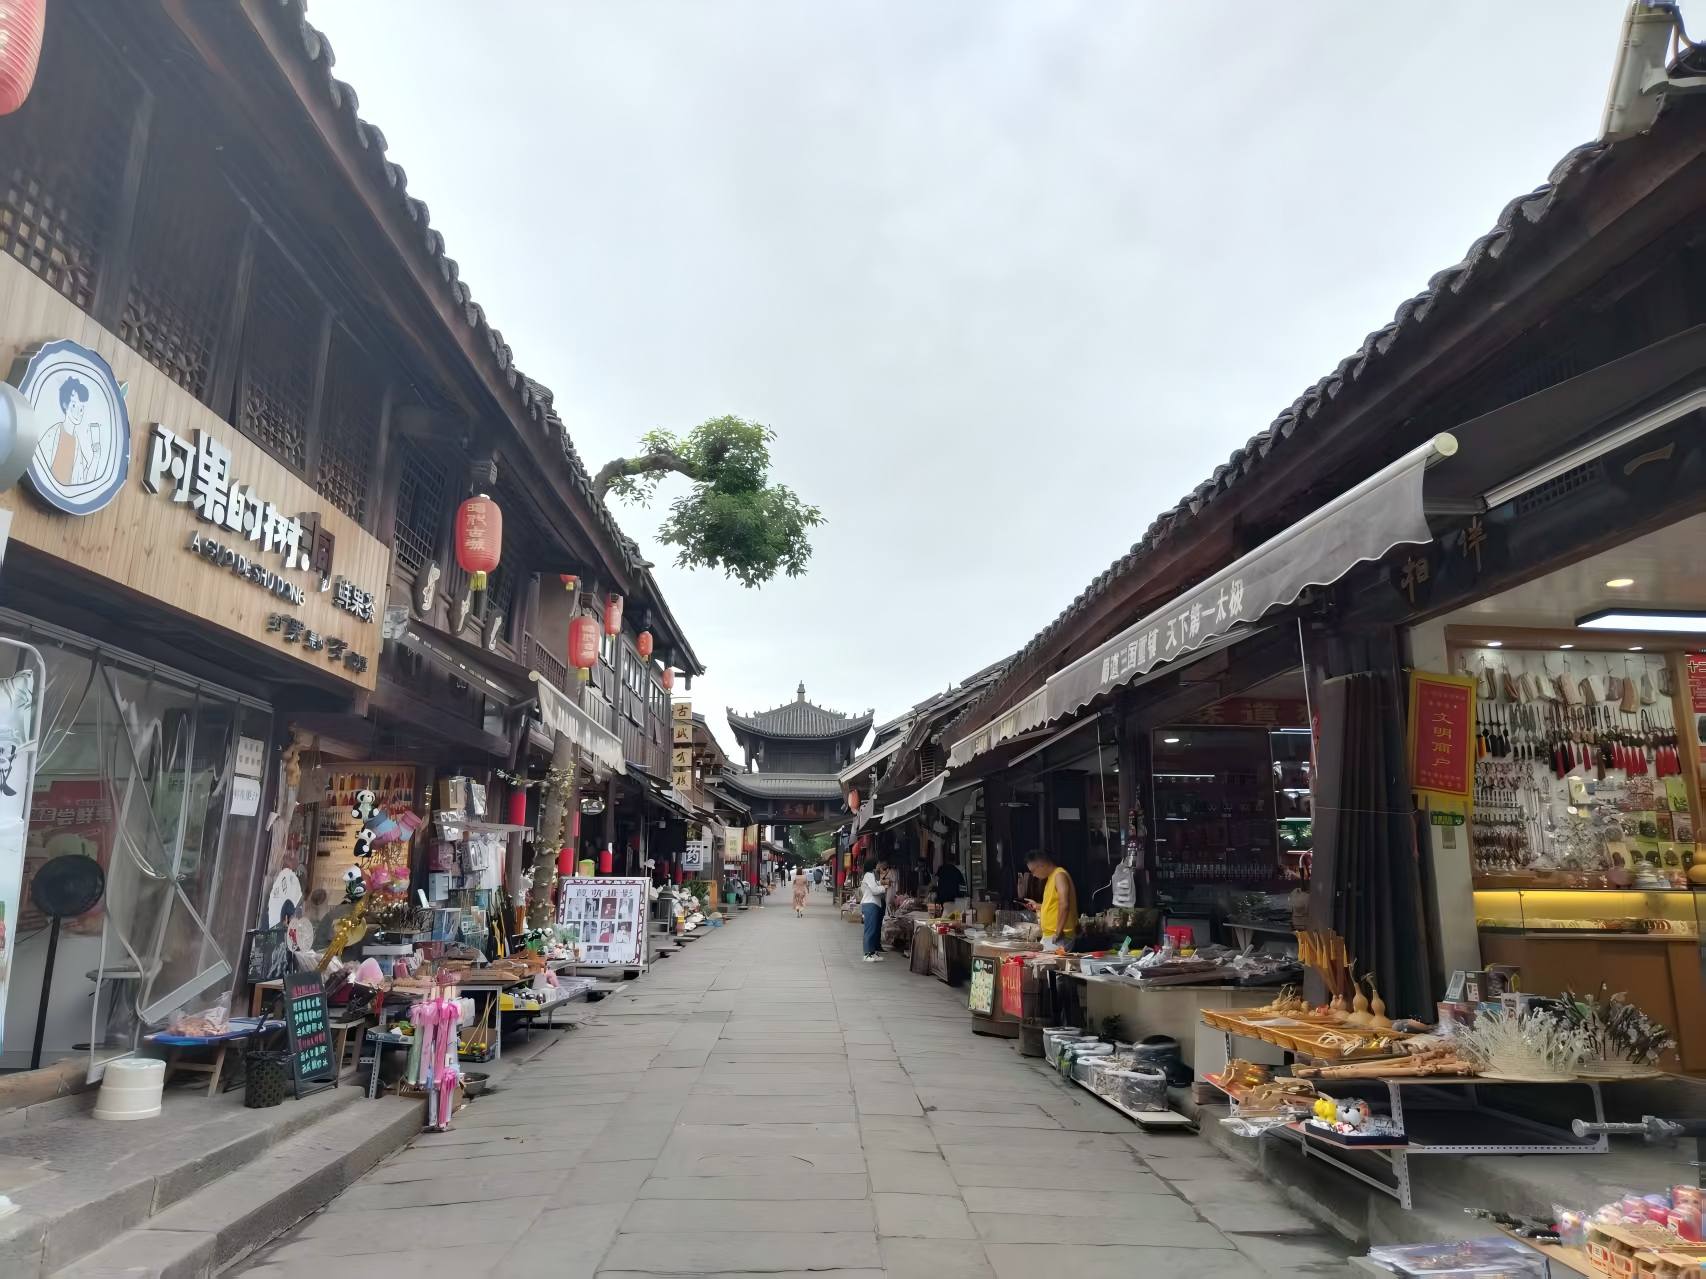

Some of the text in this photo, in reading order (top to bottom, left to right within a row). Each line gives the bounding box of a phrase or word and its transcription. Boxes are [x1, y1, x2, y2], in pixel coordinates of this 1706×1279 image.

[238, 553, 251, 577] DE
[254, 562, 274, 590] SHU
[277, 576, 305, 606] DONG
[1165, 579, 1244, 651] 天下第一太极
[1431, 712, 1455, 767] 文明商户
